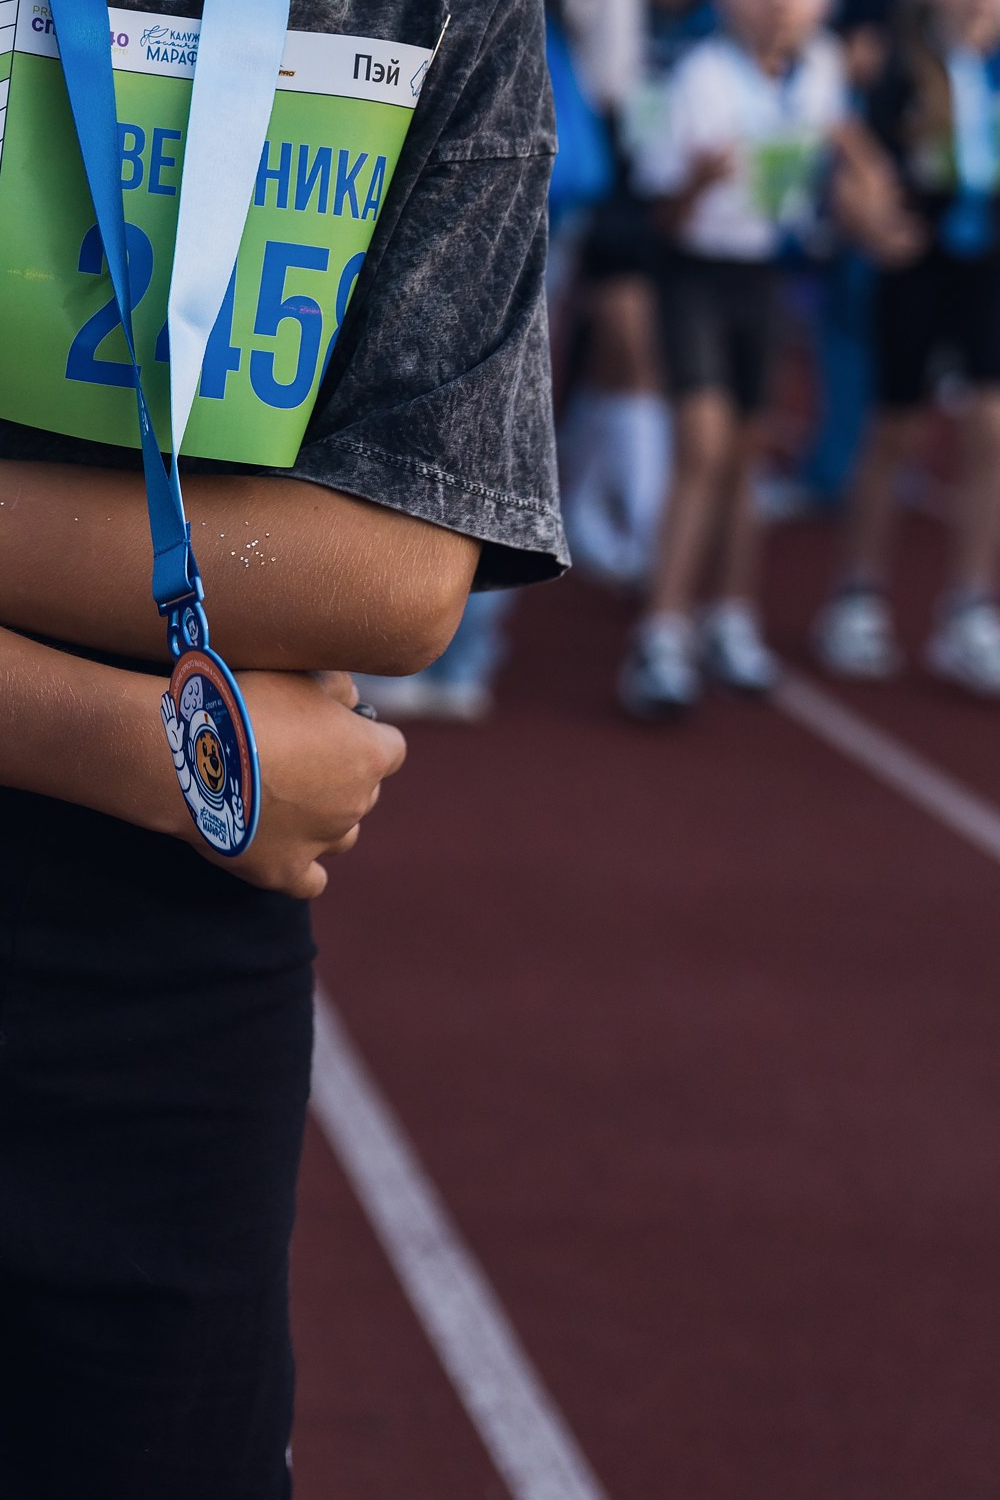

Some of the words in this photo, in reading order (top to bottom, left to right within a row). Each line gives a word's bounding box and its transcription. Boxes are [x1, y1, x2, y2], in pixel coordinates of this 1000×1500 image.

[169, 30, 200, 43] КАЛУЖ
[146, 45, 198, 66] МАРАФ
[353, 53, 401, 87] Пэй
[117, 123, 387, 222] ВЕНИКА
